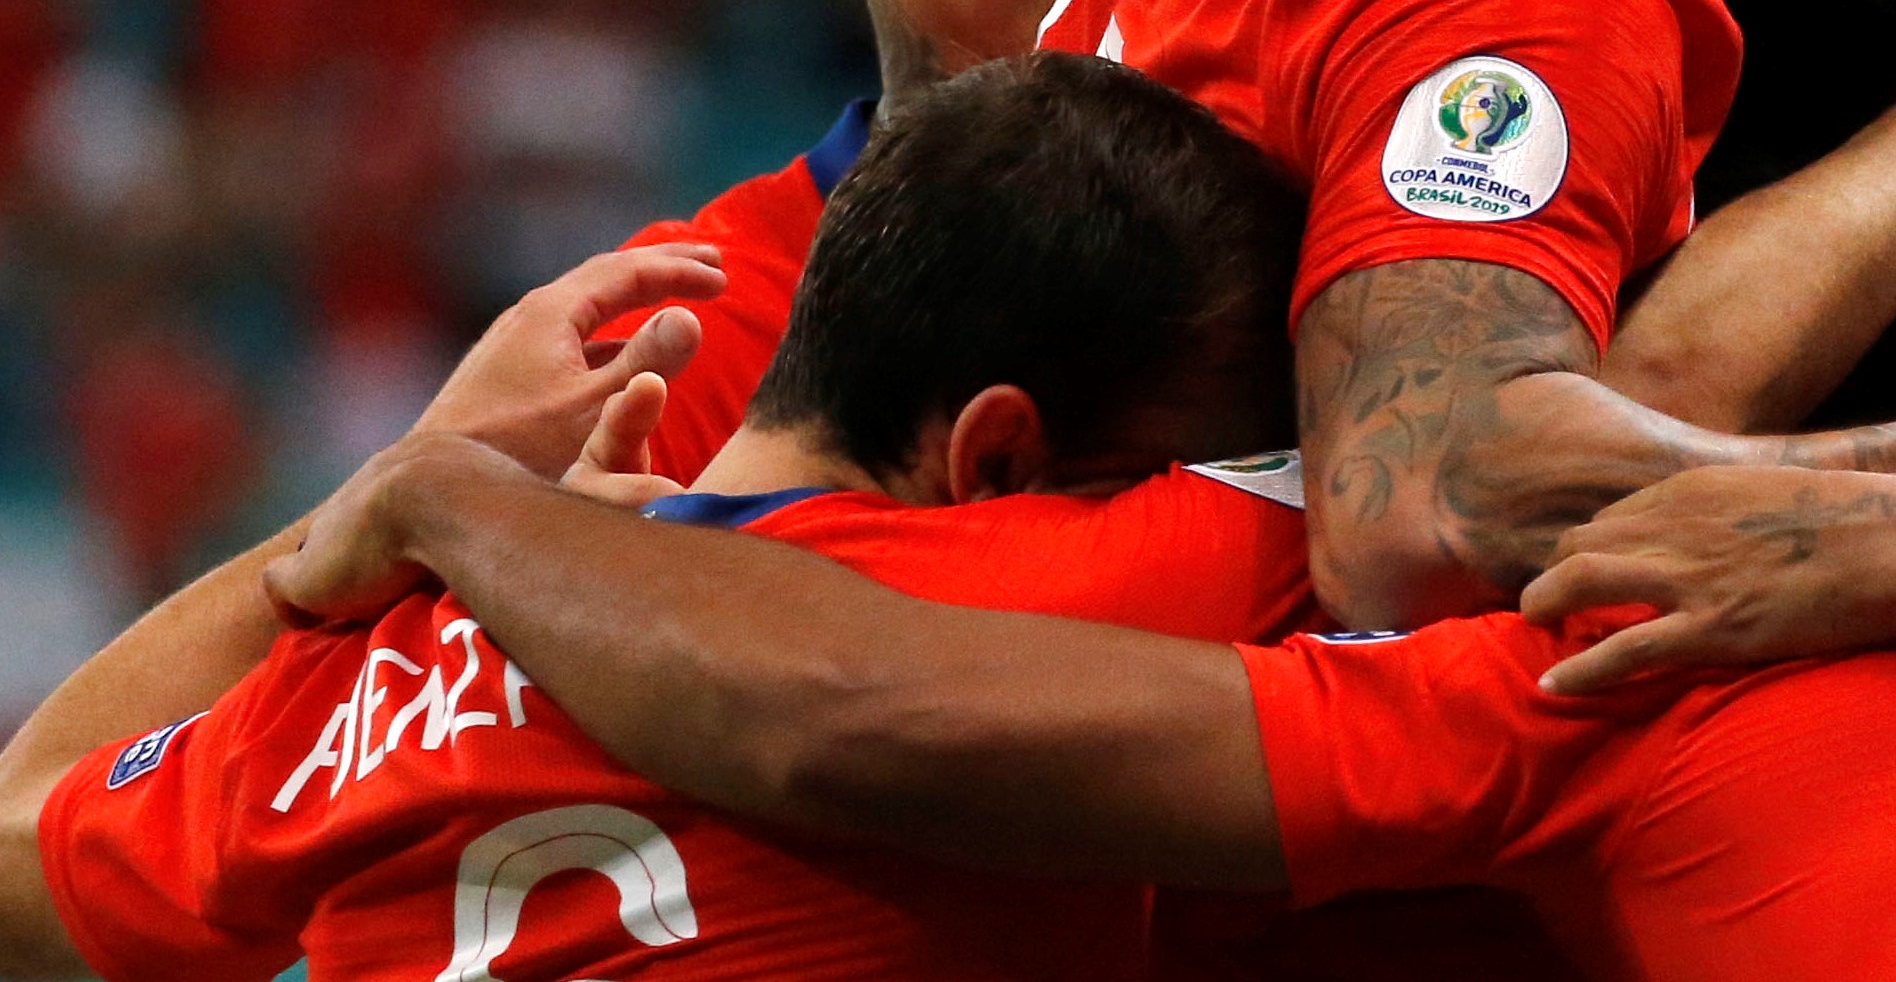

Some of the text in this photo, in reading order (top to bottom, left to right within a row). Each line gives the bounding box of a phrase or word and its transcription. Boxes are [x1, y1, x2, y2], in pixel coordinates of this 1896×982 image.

[1389, 169, 1532, 208] COPA AMERICA
[1469, 196, 1510, 215] 2019
